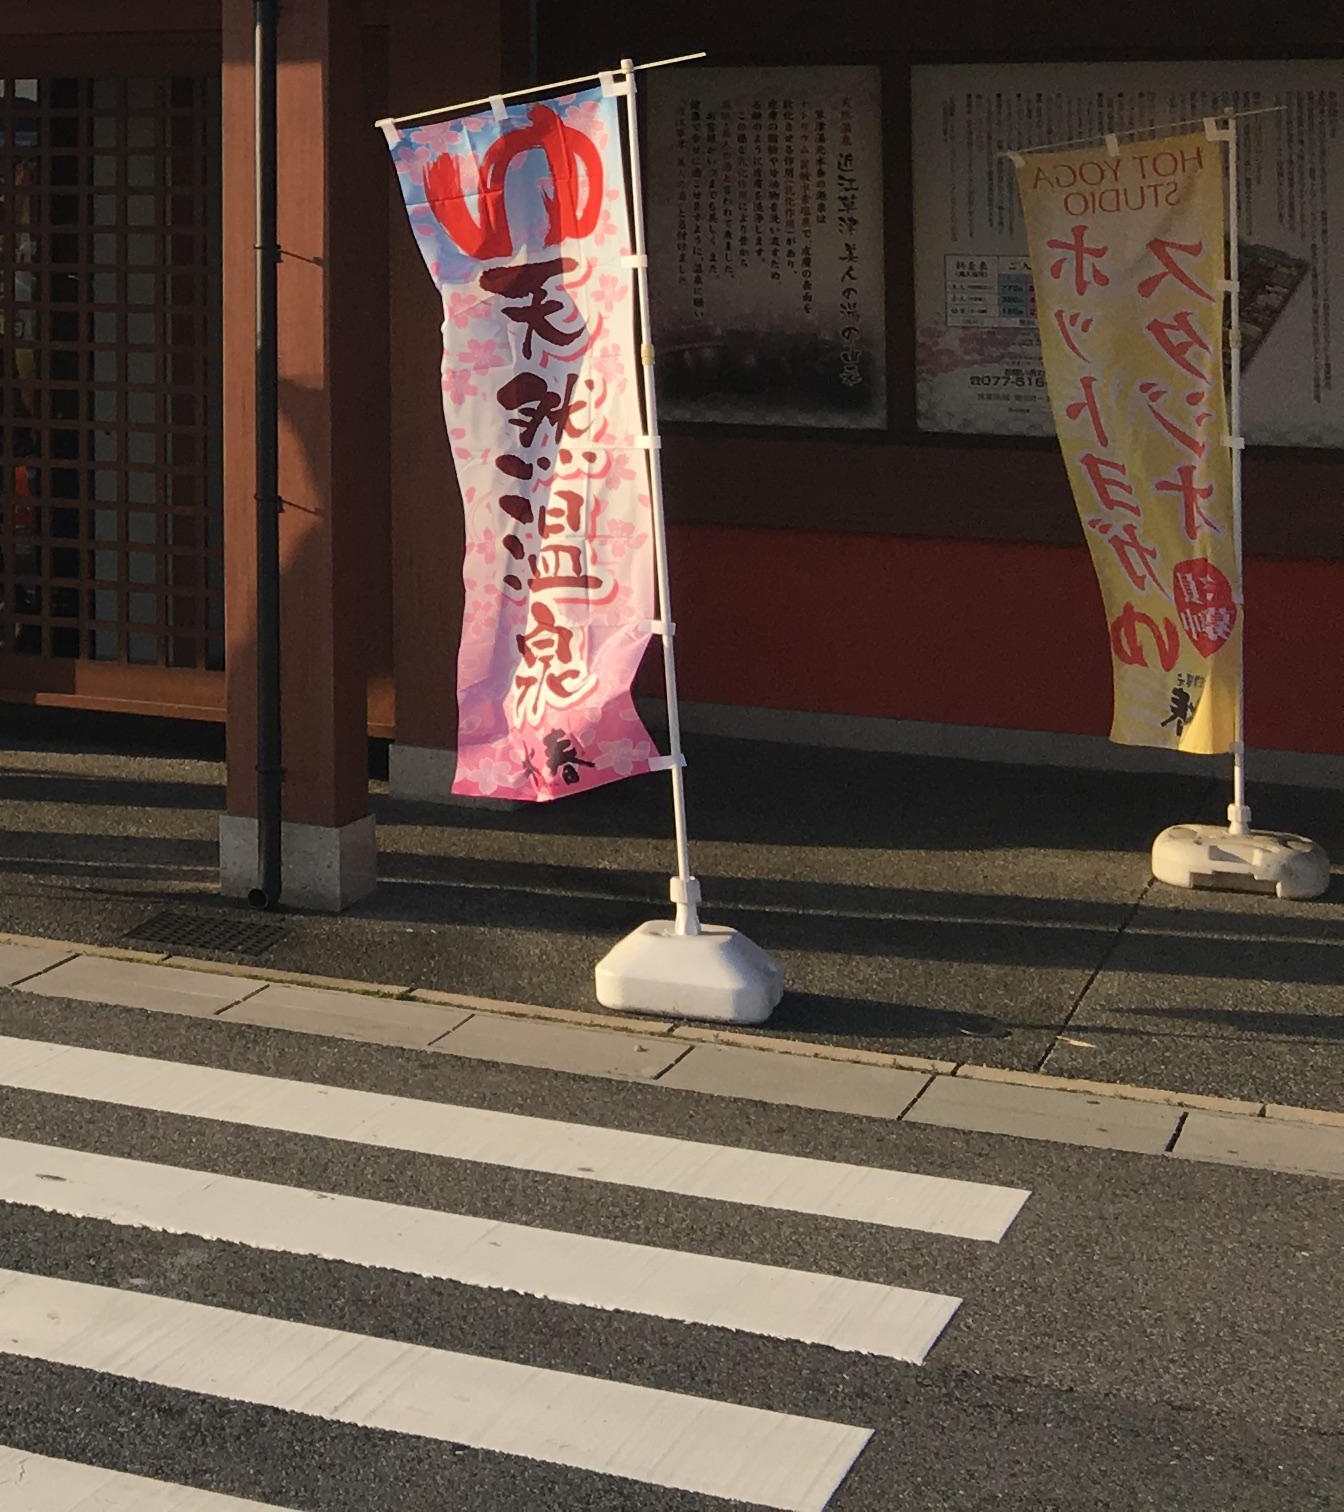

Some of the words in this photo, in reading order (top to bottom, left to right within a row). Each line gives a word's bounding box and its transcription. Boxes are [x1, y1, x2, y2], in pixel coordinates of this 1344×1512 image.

[423, 104, 604, 261] ゆ
[479, 256, 603, 705] 天然温泉
